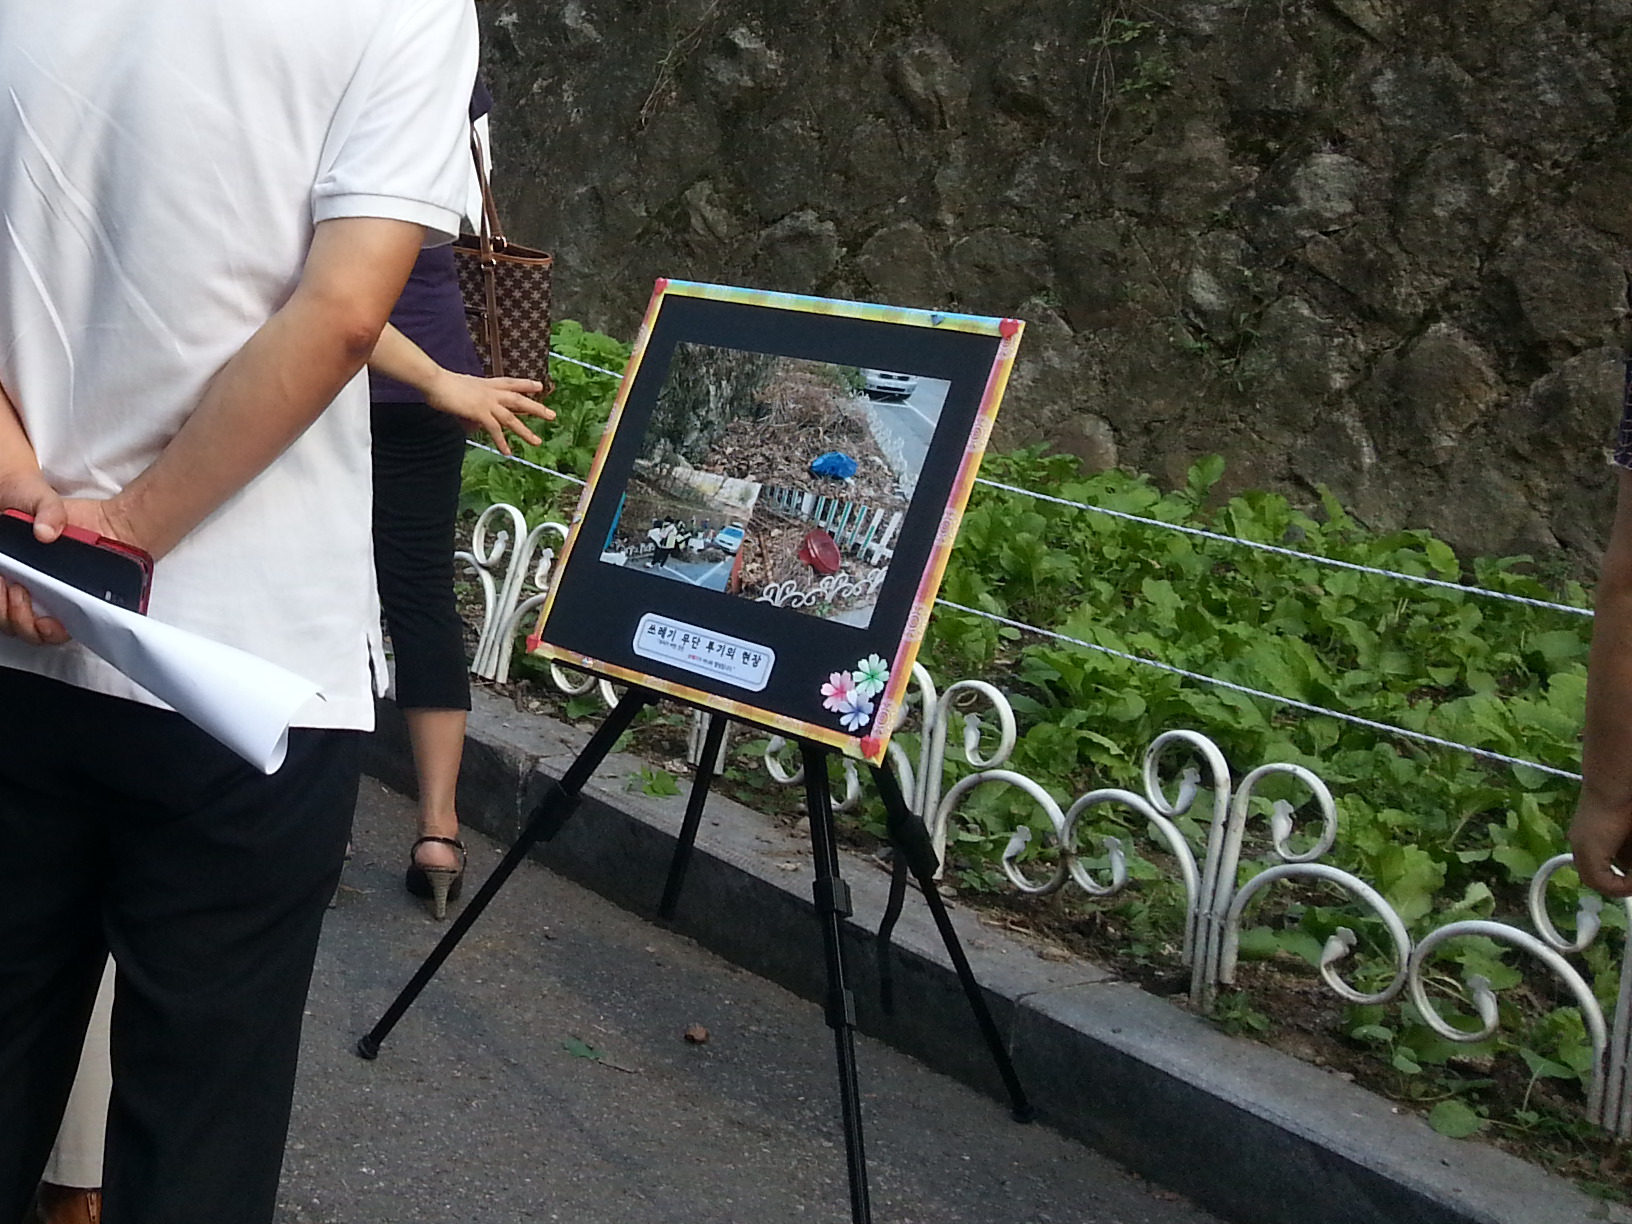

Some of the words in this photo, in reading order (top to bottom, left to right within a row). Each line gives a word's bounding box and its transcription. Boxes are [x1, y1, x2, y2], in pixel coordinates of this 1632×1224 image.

[647, 624, 677, 640] 쓰레기
[680, 632, 702, 651] 무단
[740, 649, 763, 669] 현장
